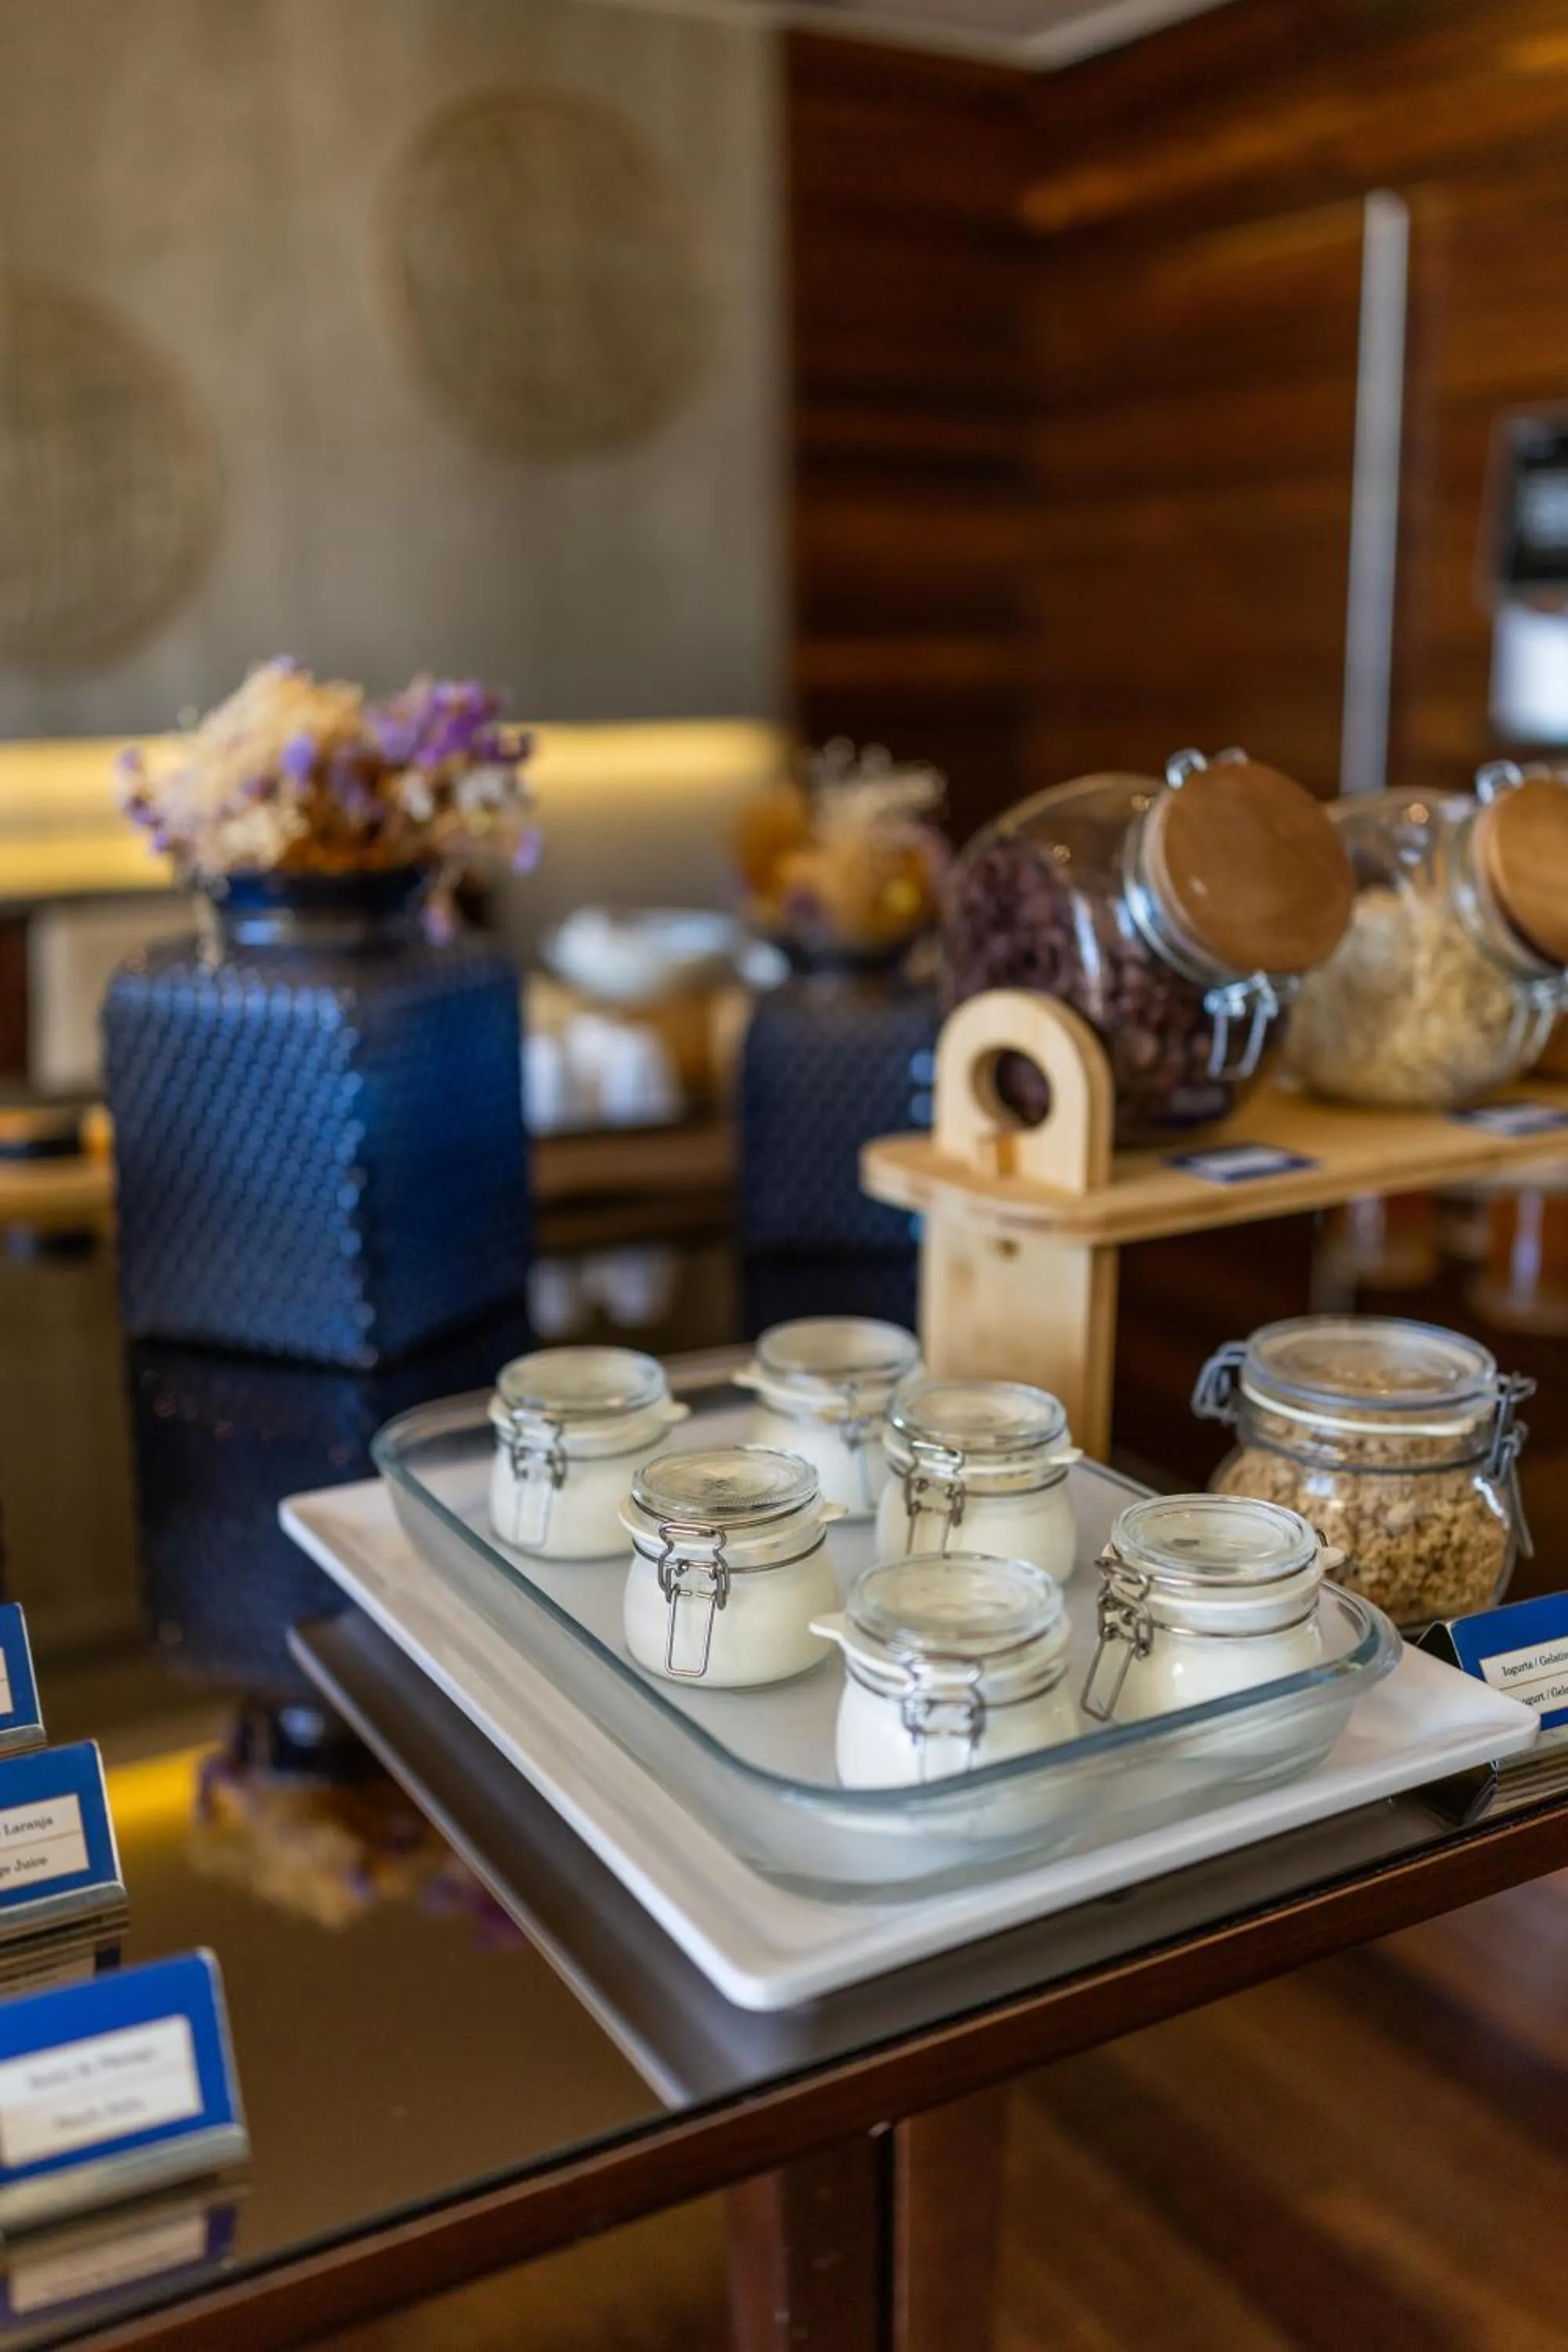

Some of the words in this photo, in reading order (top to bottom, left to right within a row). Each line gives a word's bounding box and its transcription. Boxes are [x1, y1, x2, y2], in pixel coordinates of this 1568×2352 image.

[1501, 1661, 1534, 1677] Iogurte
[1520, 1693, 1545, 1706] ogurt
[3, 1815, 53, 1835] Laranja
[13, 1856, 48, 1872] Juice
